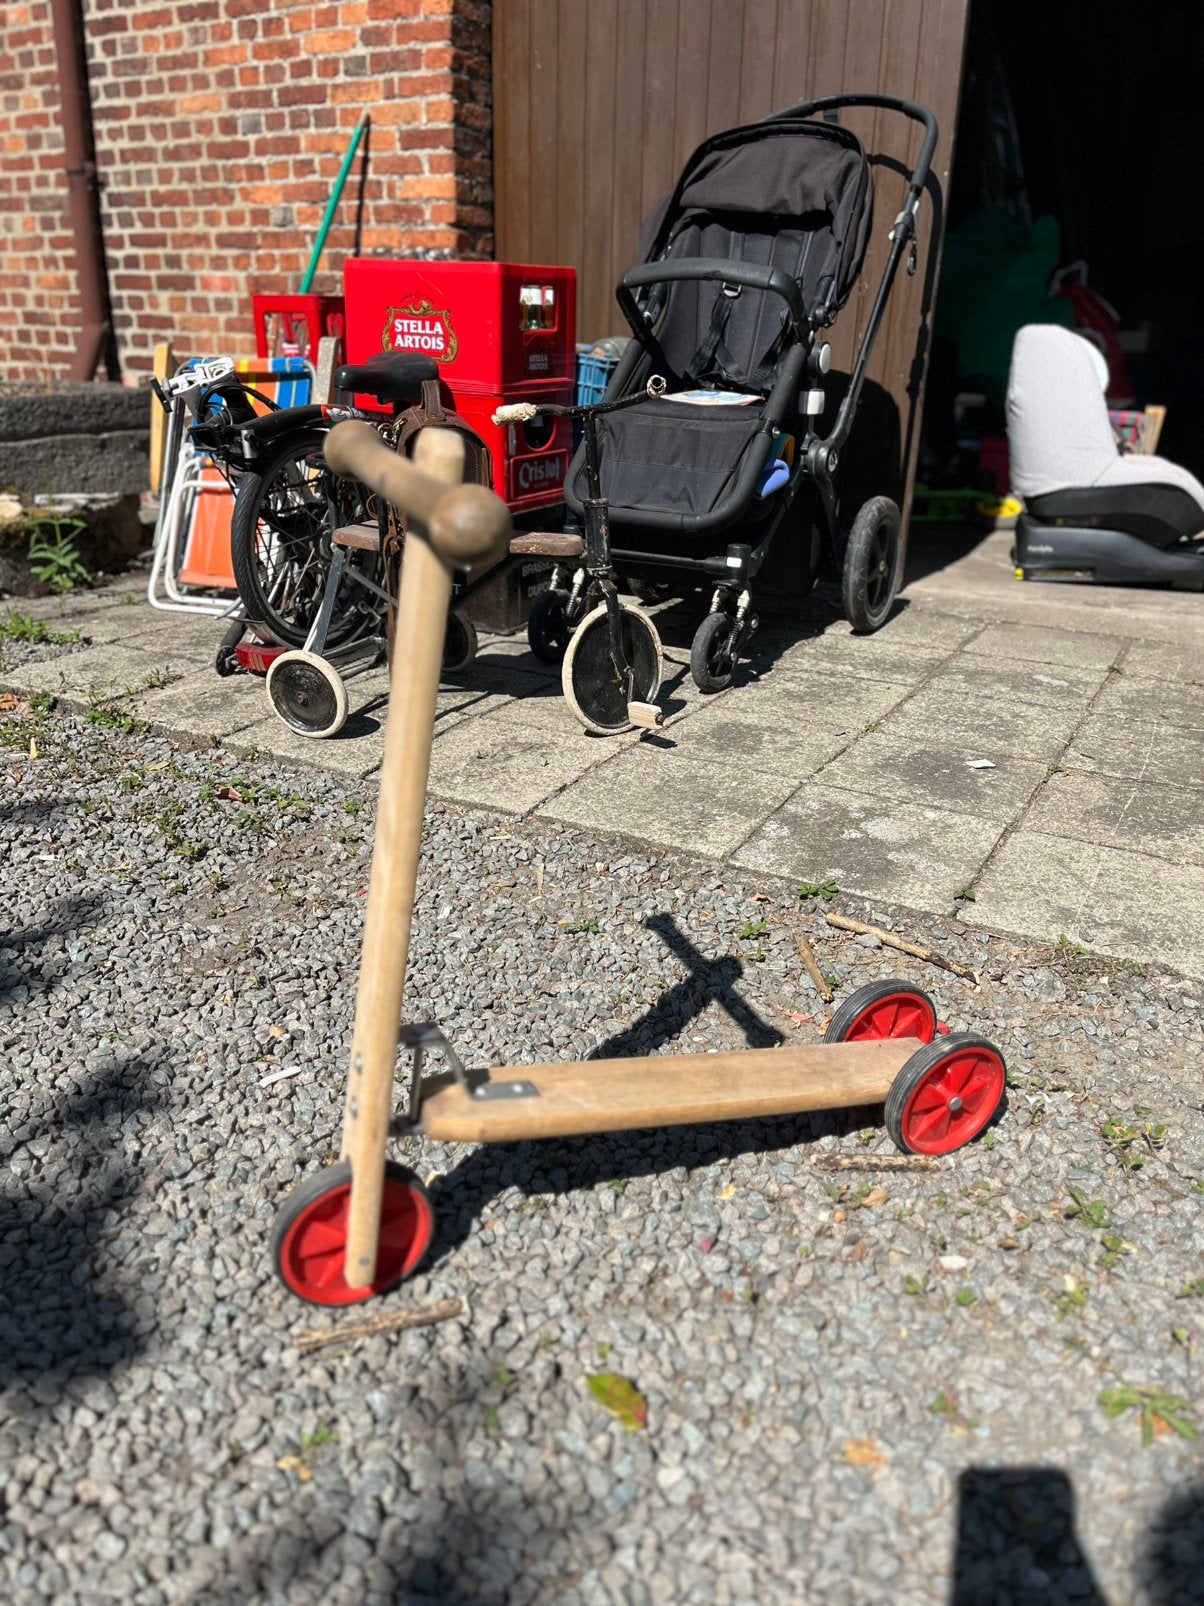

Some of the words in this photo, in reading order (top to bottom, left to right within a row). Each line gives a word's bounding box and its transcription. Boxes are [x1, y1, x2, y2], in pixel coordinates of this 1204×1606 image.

[394, 319, 444, 335] STELLA
[394, 334, 445, 351] ARTOIS
[528, 353, 549, 362] STELLA
[528, 362, 549, 370] ARTOIS
[518, 457, 560, 489] Cristal
[521, 561, 552, 577] BRASSE
[528, 581, 550, 598] DUPO
